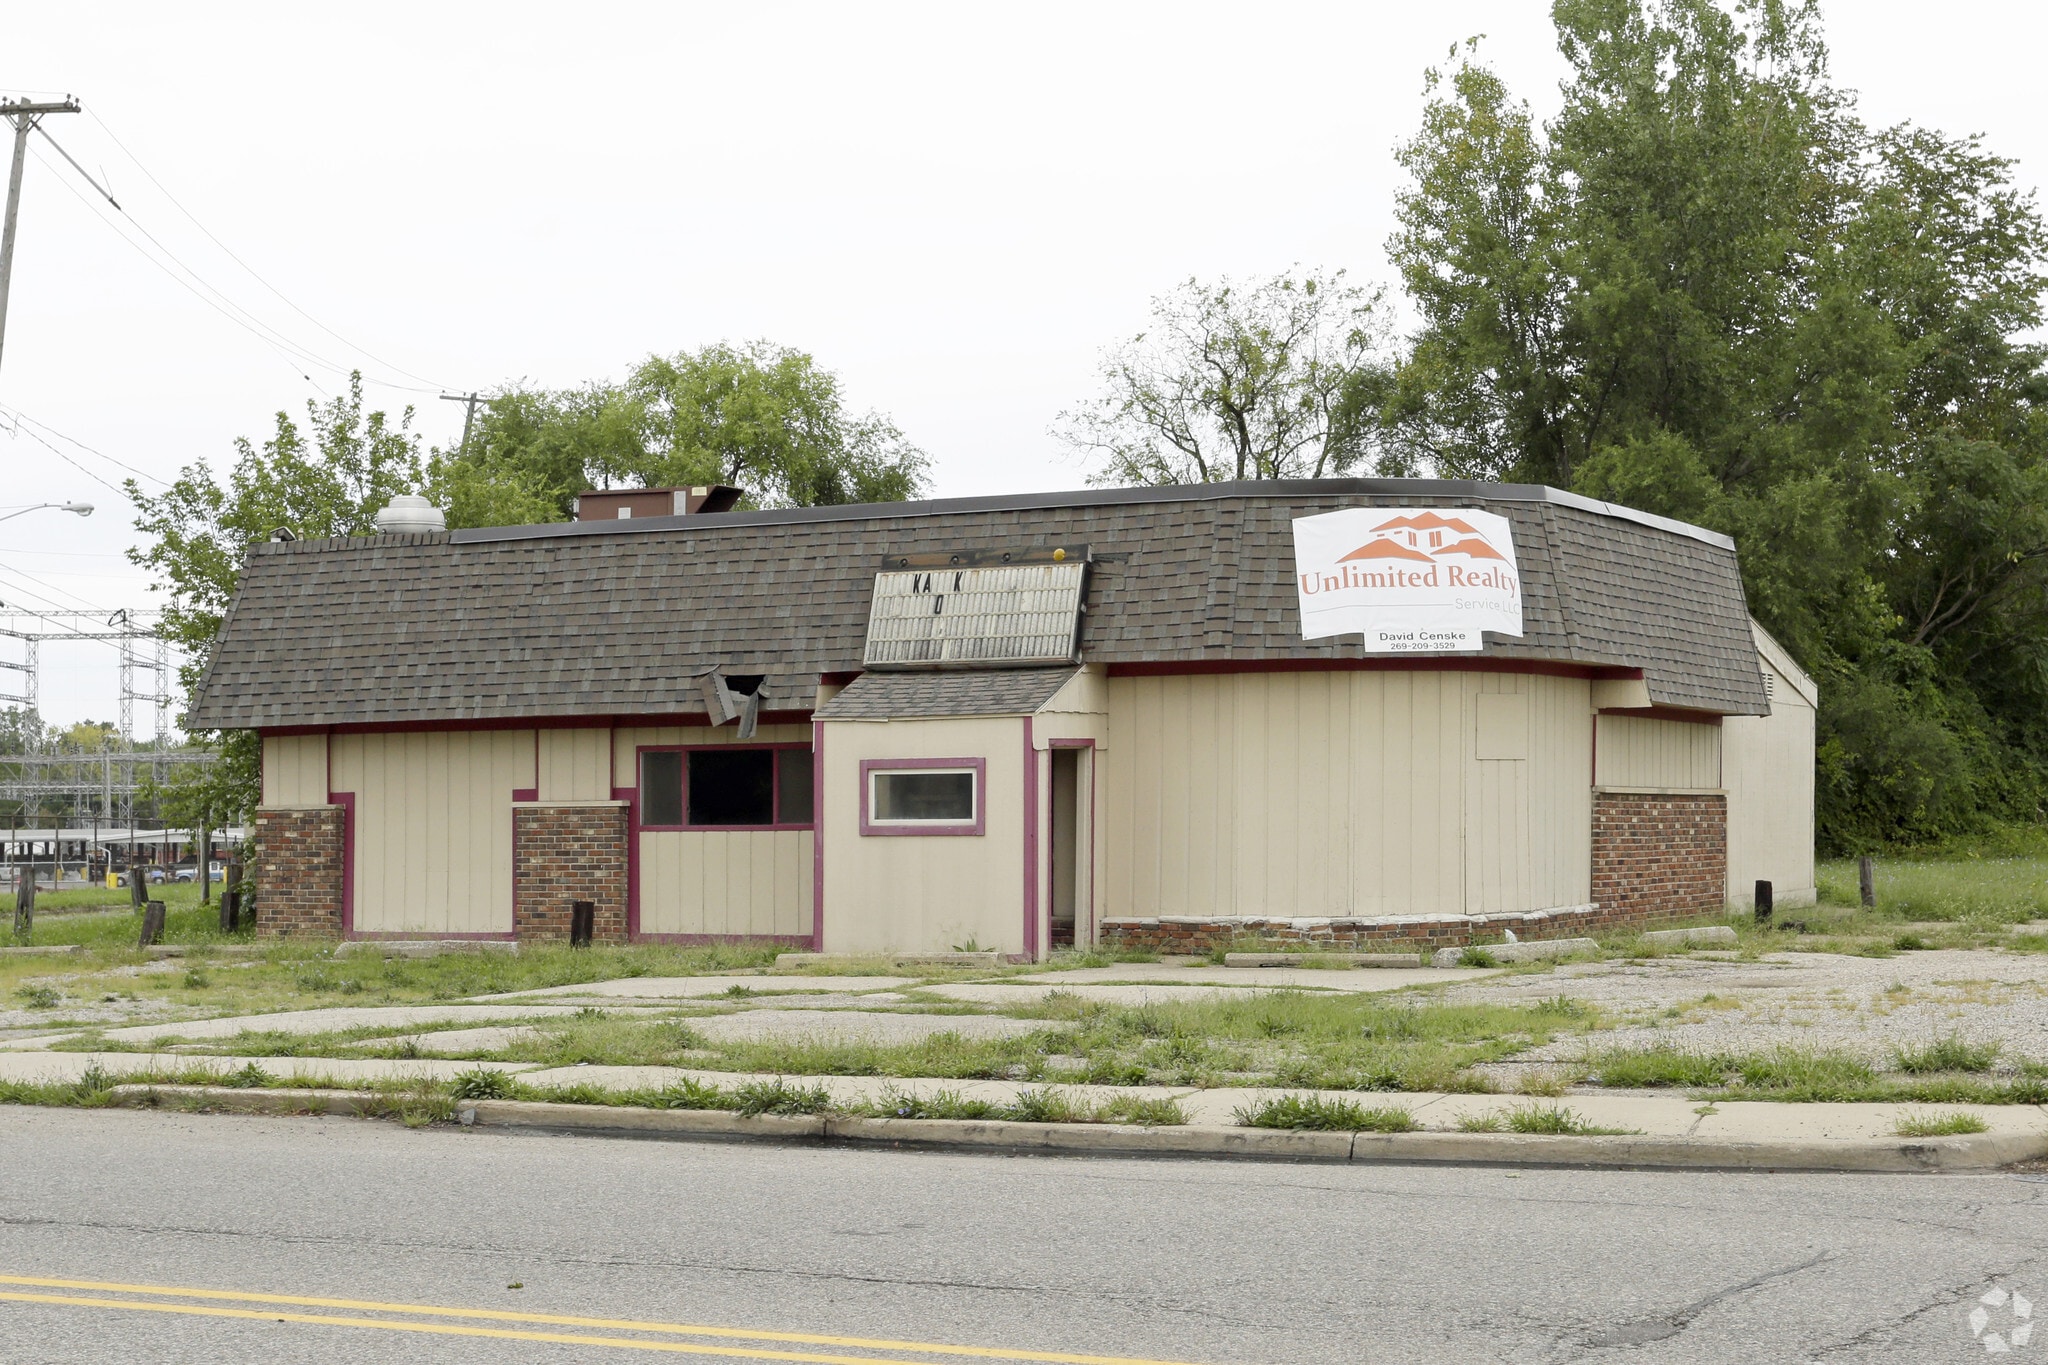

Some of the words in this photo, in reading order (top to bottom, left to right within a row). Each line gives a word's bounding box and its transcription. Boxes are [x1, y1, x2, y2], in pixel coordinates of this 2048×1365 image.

[954, 571, 963, 592] K
[1299, 565, 1439, 595] Unlimited
[1447, 565, 1517, 598] Realty
[1455, 597, 1500, 611] Service
[1502, 600, 1520, 615] LLC
[1379, 631, 1414, 641] David
[1419, 631, 1466, 641] Censke
[1390, 642, 1456, 650] 269-209-3529
